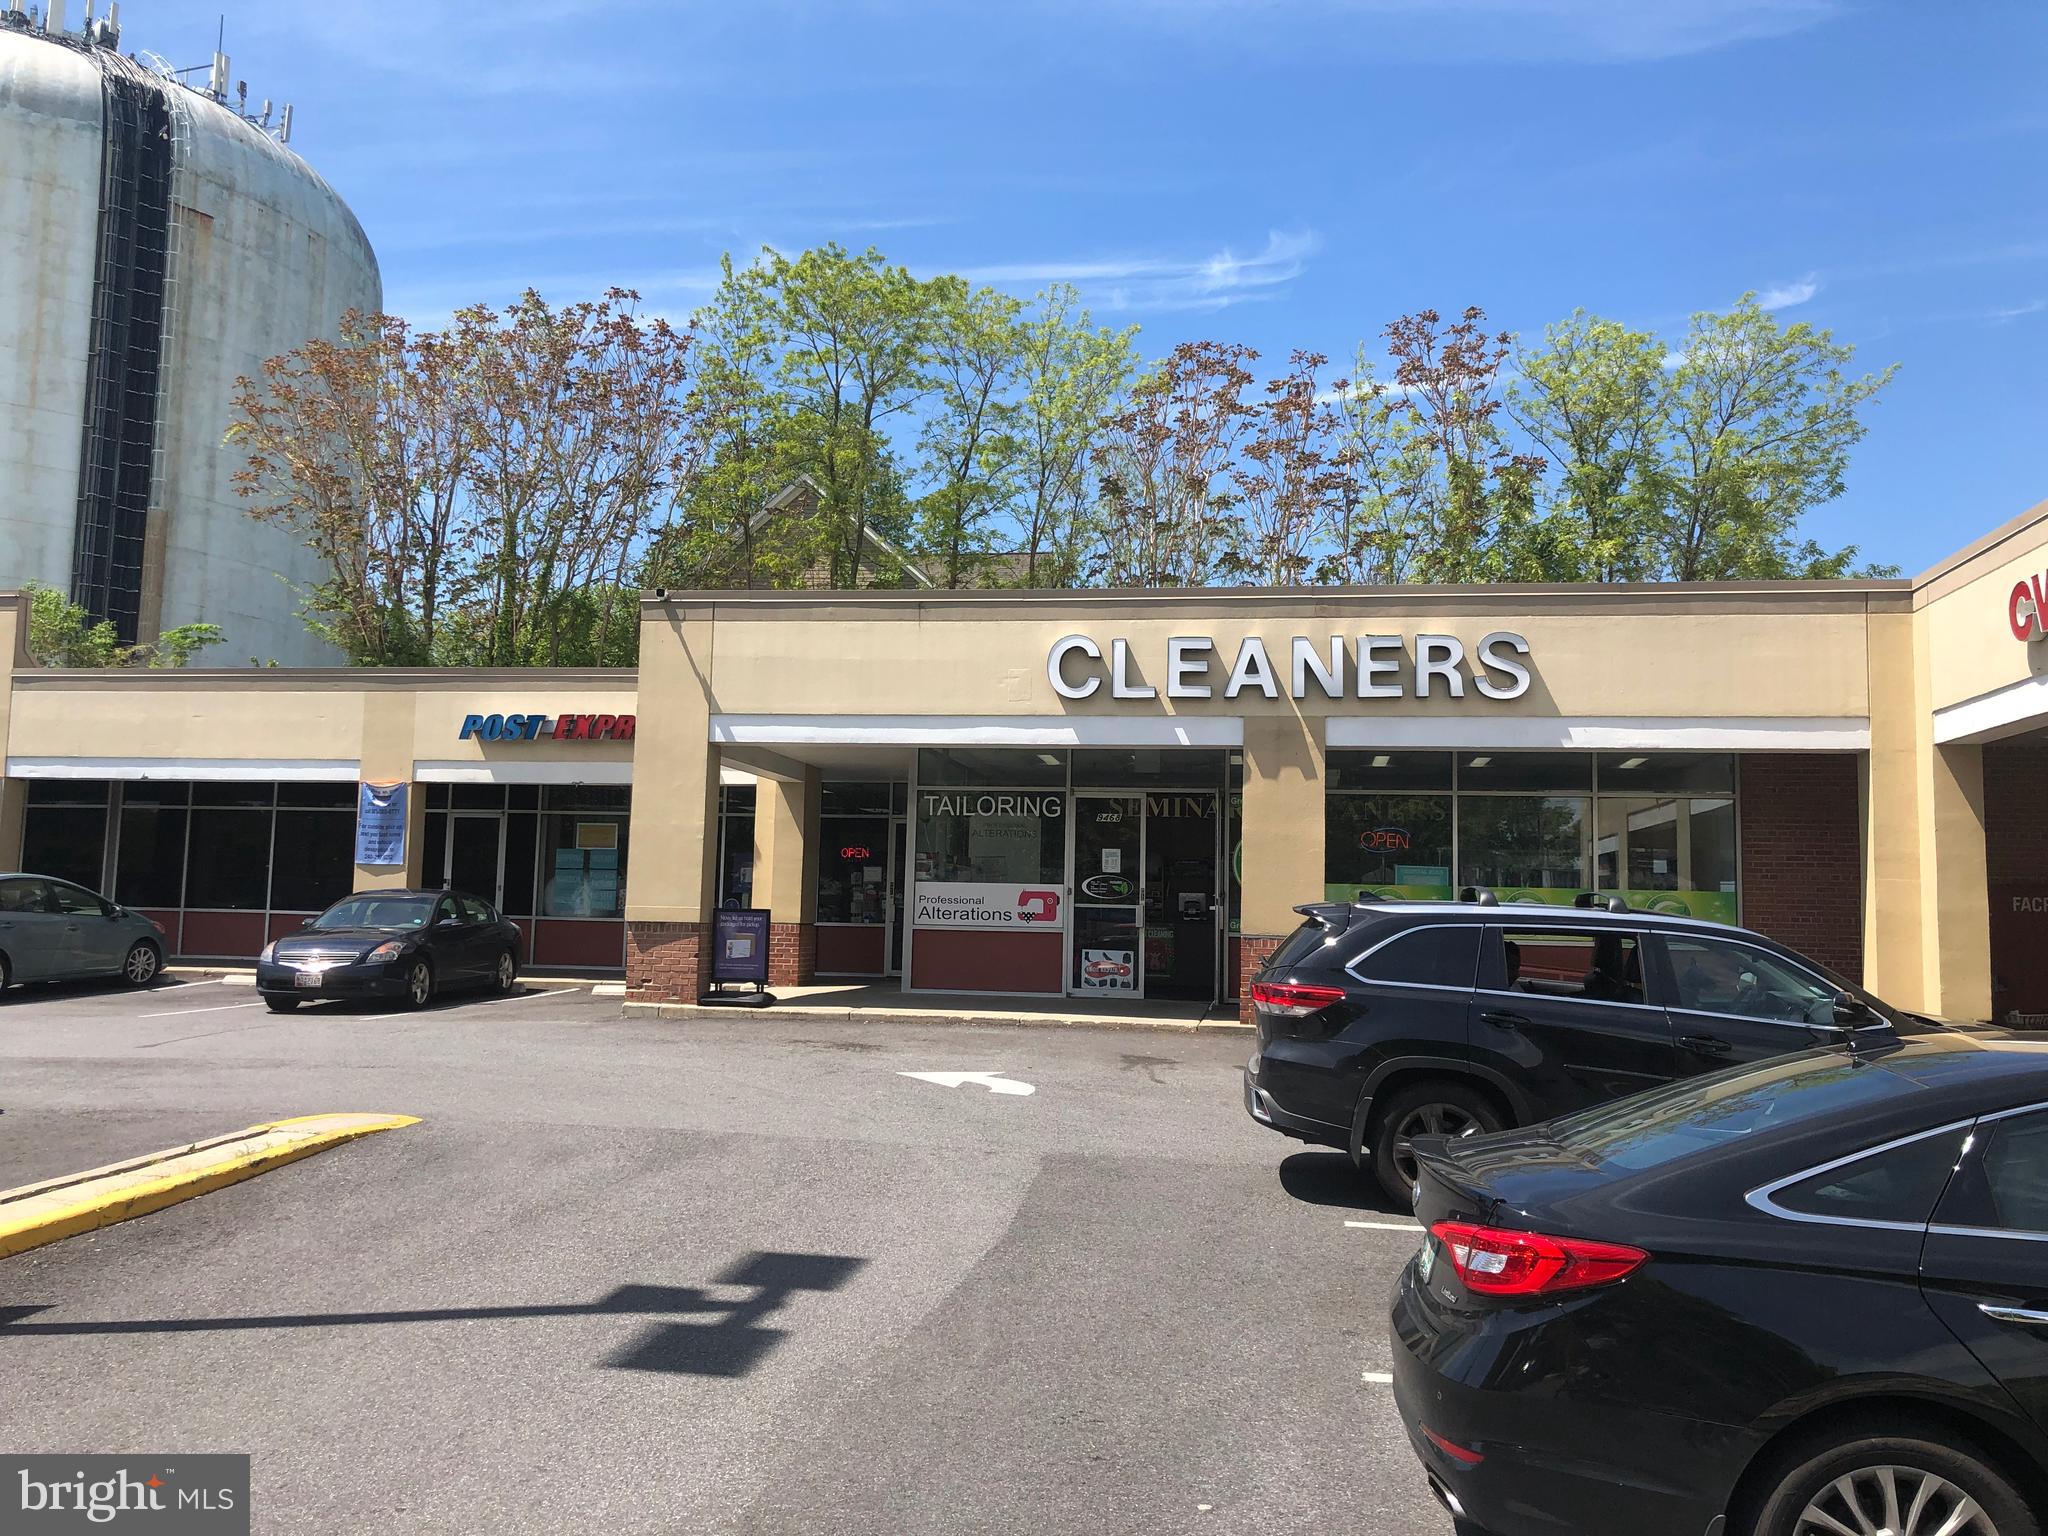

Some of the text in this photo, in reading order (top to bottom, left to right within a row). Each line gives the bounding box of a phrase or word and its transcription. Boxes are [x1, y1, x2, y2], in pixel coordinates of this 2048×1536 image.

[1047, 631, 1532, 701] CLEANERS
[458, 714, 546, 741] POST
[924, 795, 1061, 817] TAILORING
[1097, 814, 1121, 822] 9468
[971, 829, 1038, 839] ALTERATIONS
[1360, 831, 1409, 849] OPEN
[841, 847, 870, 858] OPEN
[918, 894, 985, 905] Professional
[918, 905, 1012, 922] Alterations
